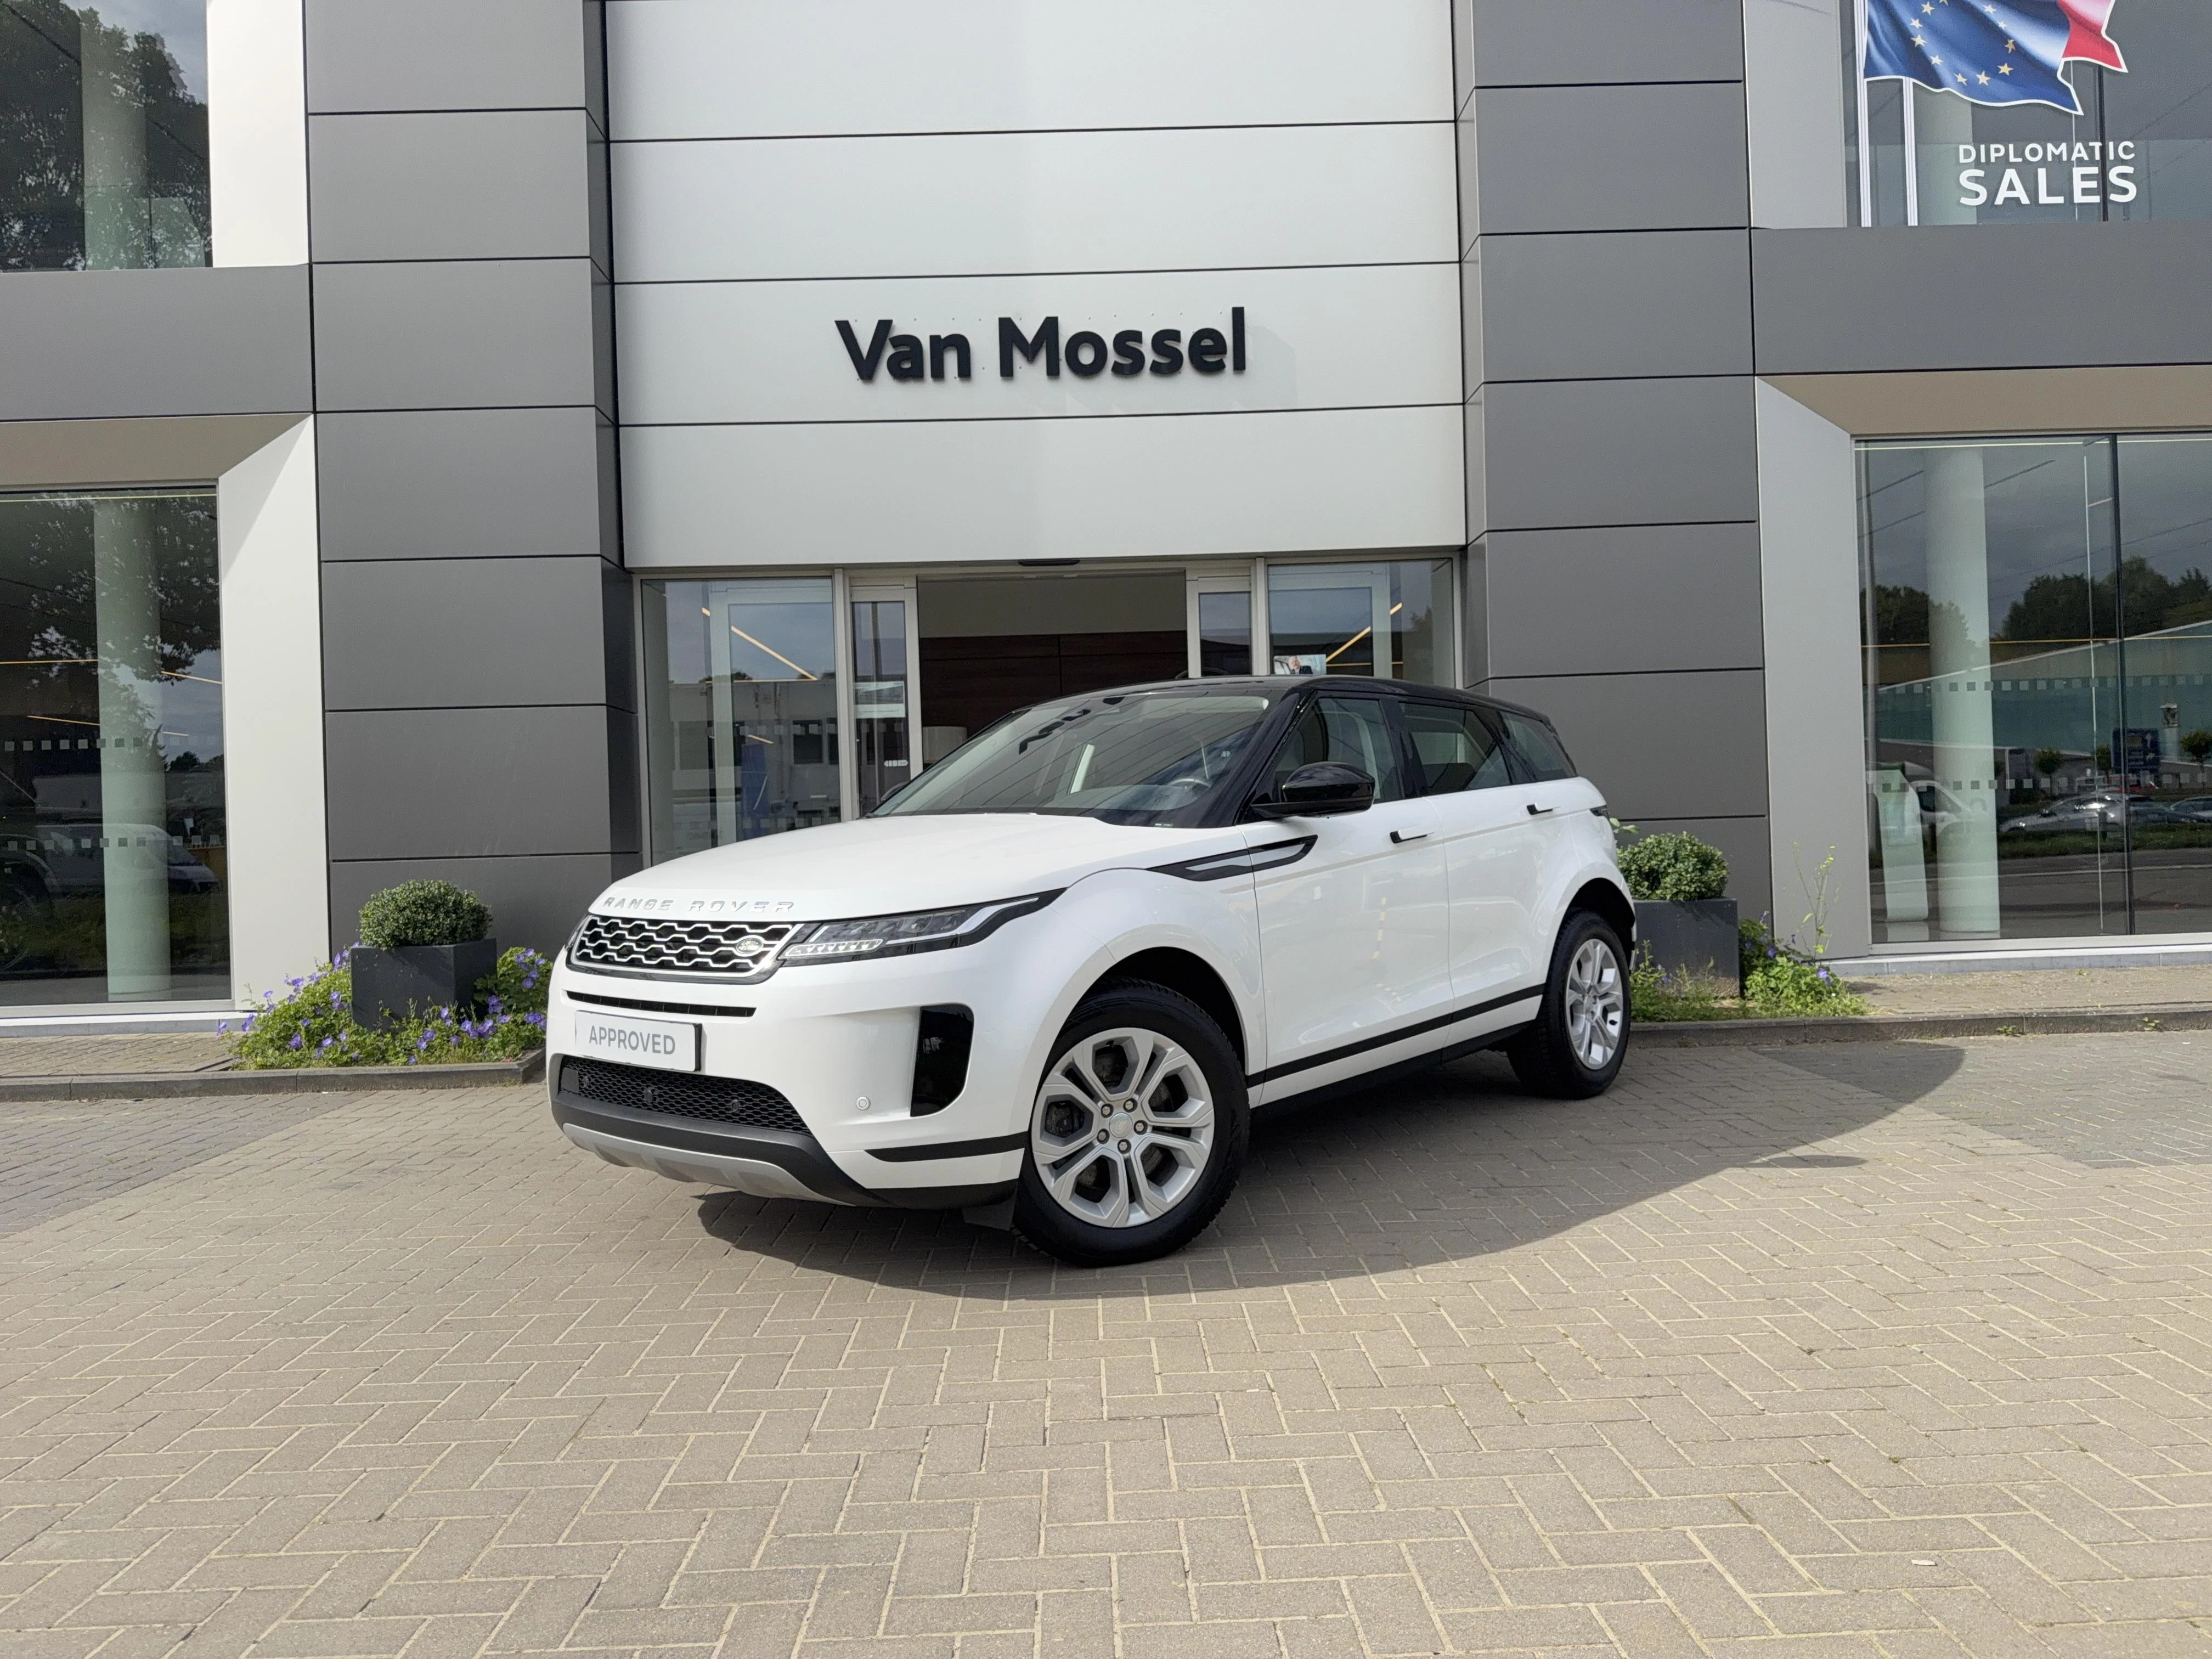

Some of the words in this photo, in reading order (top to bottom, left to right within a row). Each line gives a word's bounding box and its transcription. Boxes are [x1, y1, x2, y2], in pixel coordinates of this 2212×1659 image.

[1959, 141, 2135, 163] DIPLOMATIC
[1959, 166, 2137, 206] SALES
[835, 320, 972, 383] Van
[998, 307, 1246, 380] Mossel
[602, 897, 674, 911] RANGE
[689, 900, 794, 912] ROVER
[589, 1025, 675, 1055] APPROVED
